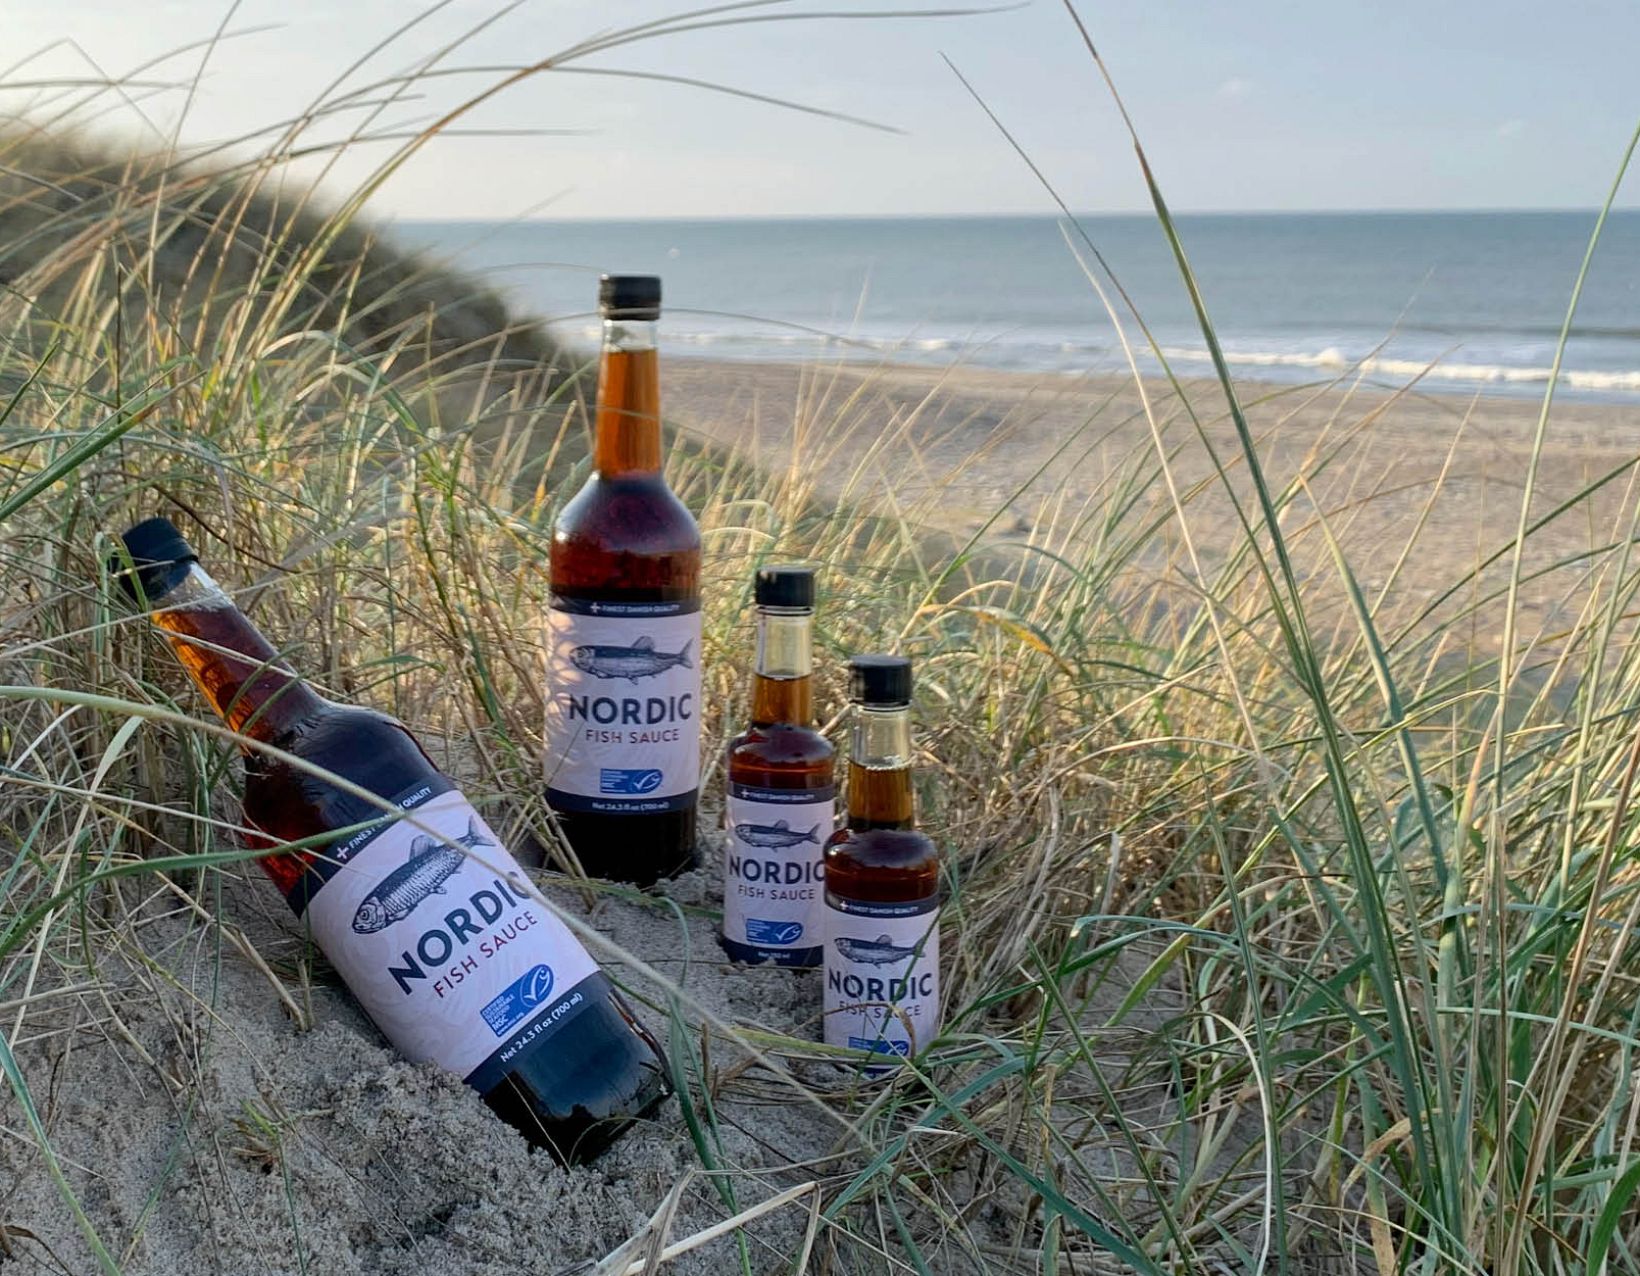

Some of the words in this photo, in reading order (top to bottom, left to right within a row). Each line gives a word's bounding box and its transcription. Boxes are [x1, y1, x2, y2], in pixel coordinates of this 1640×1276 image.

[569, 692, 693, 726] NORDIC
[585, 729, 622, 744] FISH
[630, 728, 680, 744] SAUCE
[402, 786, 432, 808] QUALITY
[729, 855, 825, 885] NORDIC
[738, 885, 765, 899] FISH
[770, 889, 815, 901] SAUCE
[388, 871, 531, 995] NORDIC
[432, 955, 477, 998] FISH
[479, 910, 538, 959] SAUCE
[829, 968, 933, 1002] NORDIC
[491, 1014, 509, 1031] MSC
[500, 1046, 518, 1062] Net
[515, 1030, 536, 1049] 24.3
[551, 1001, 572, 1020] (700
[569, 992, 584, 1006] ml)
